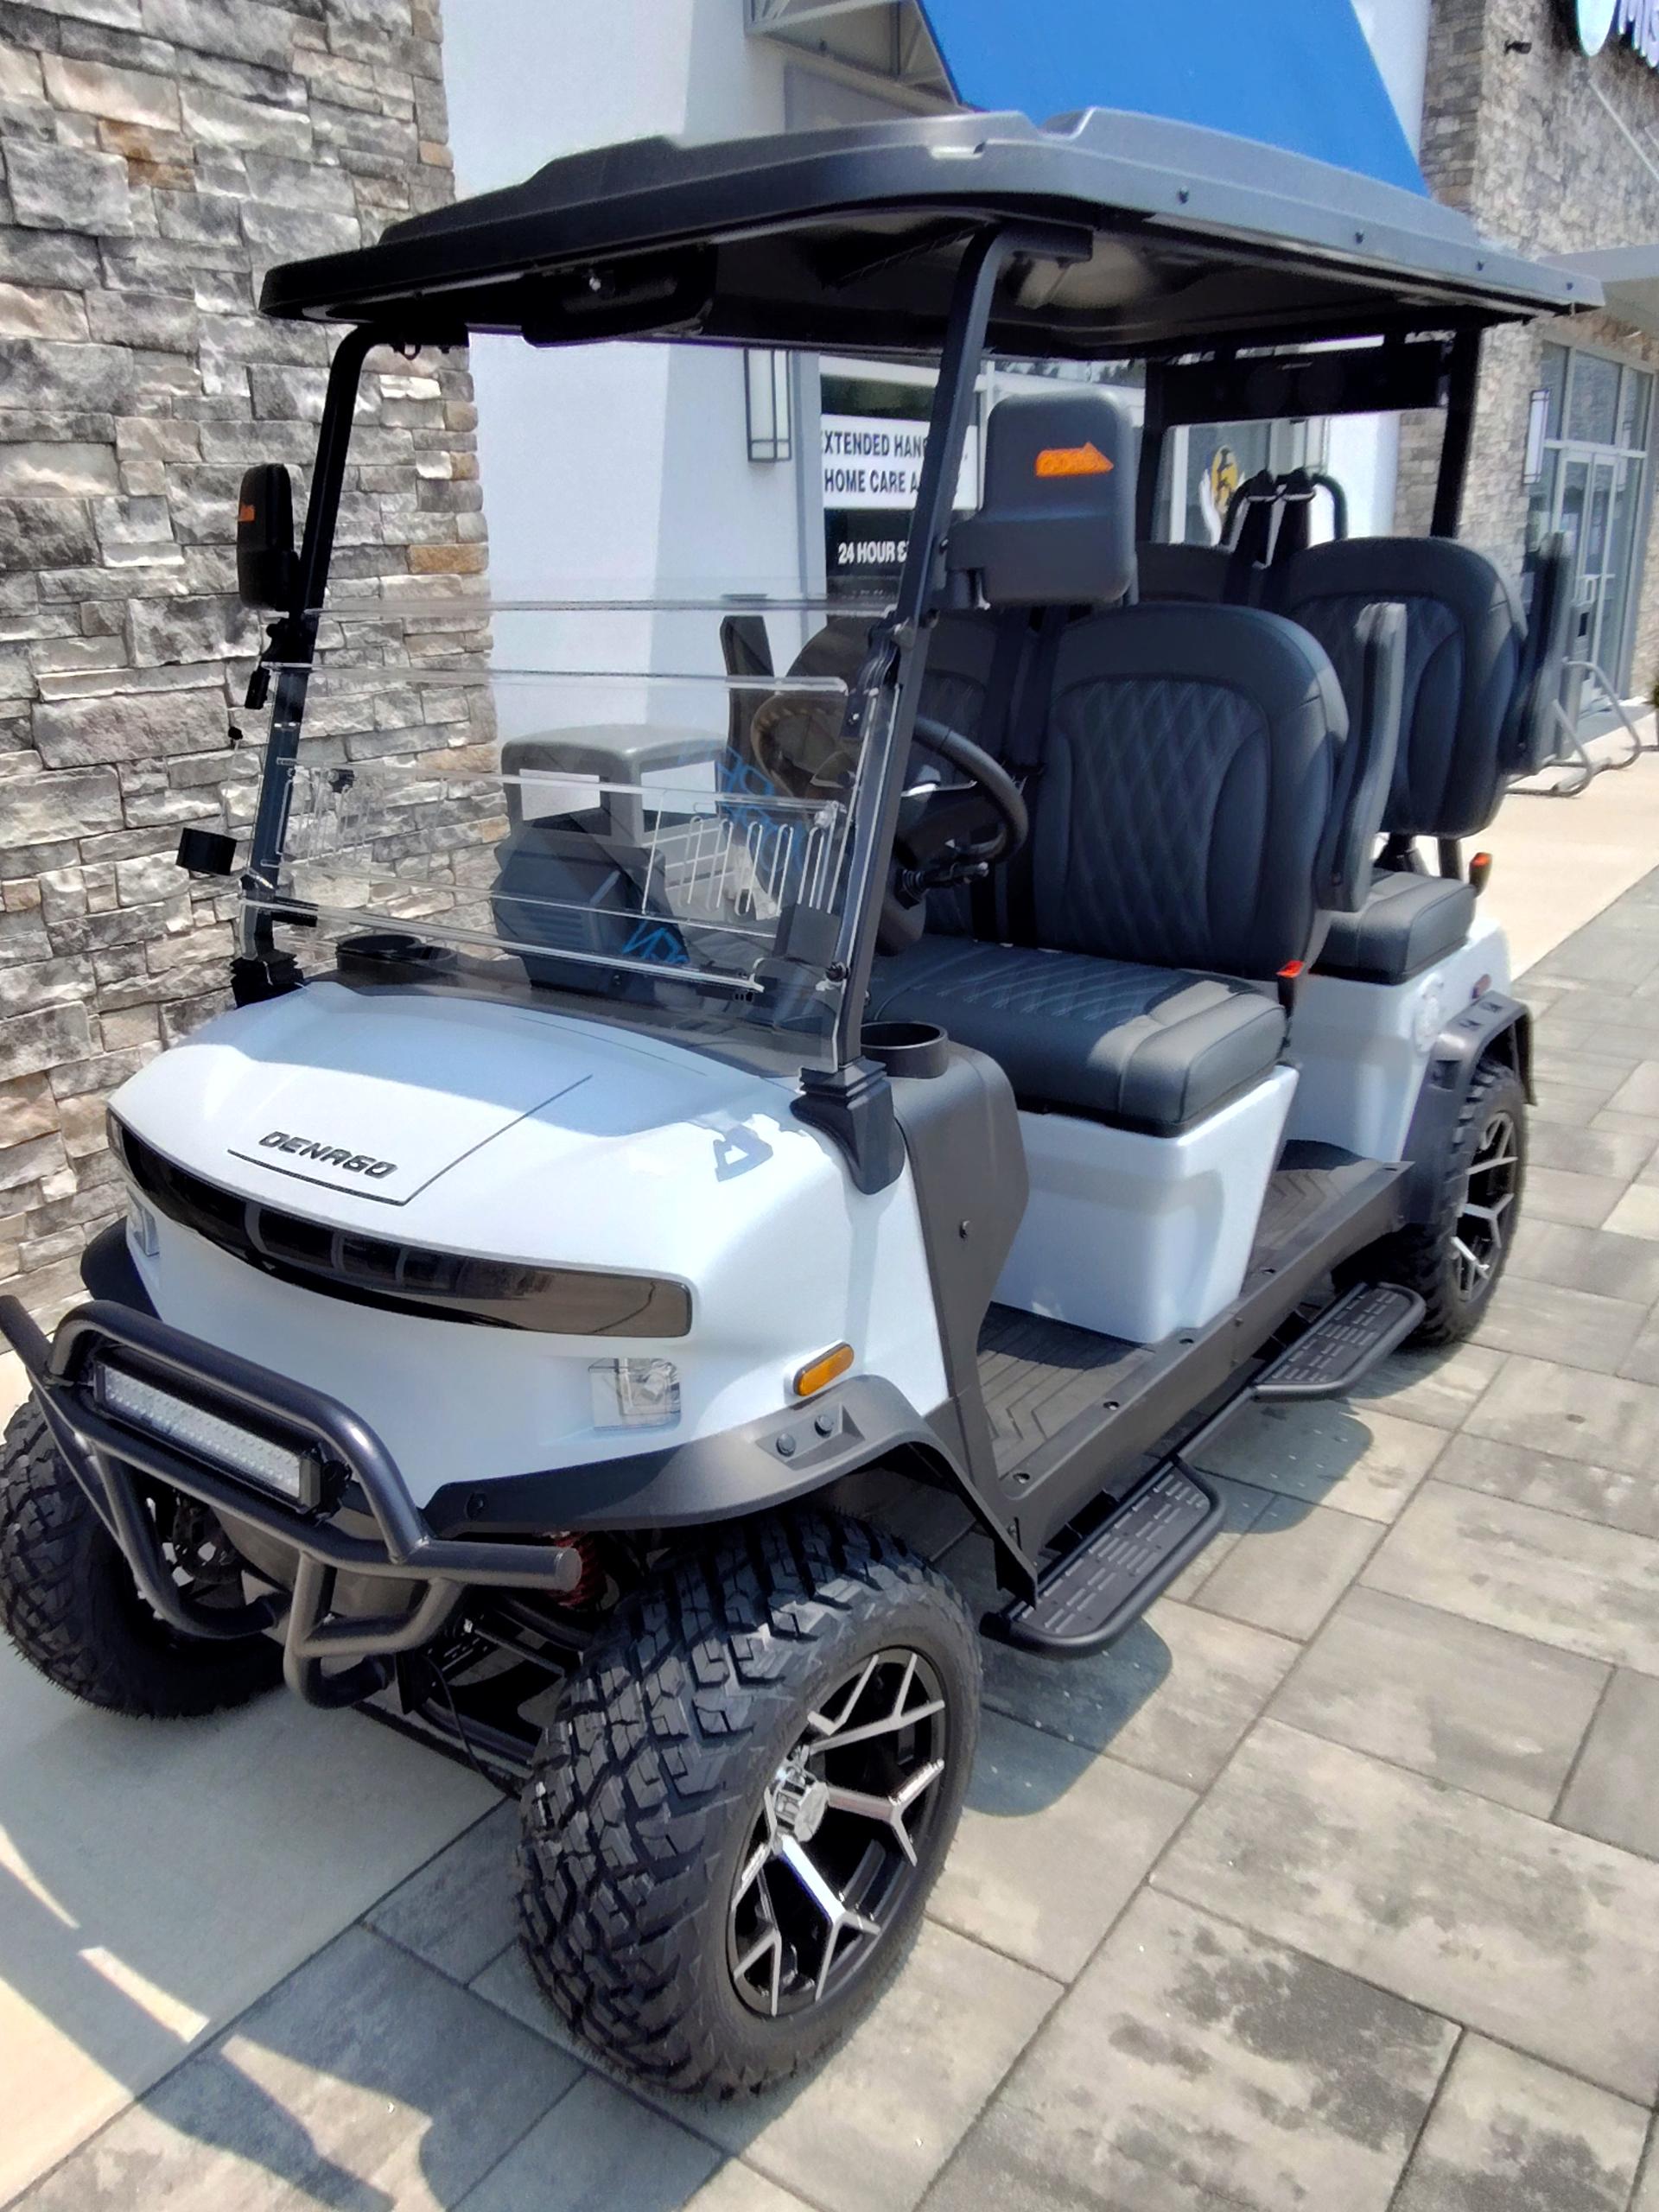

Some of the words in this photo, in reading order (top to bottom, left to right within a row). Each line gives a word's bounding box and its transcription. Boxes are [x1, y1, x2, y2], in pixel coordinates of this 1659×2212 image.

[822, 430, 889, 456] XTENDED
[824, 469, 866, 493] HOME
[870, 470, 906, 493] CARE
[838, 542, 855, 564] 24
[857, 541, 895, 563] HOUR
[258, 1131, 398, 1179] DENAGO
